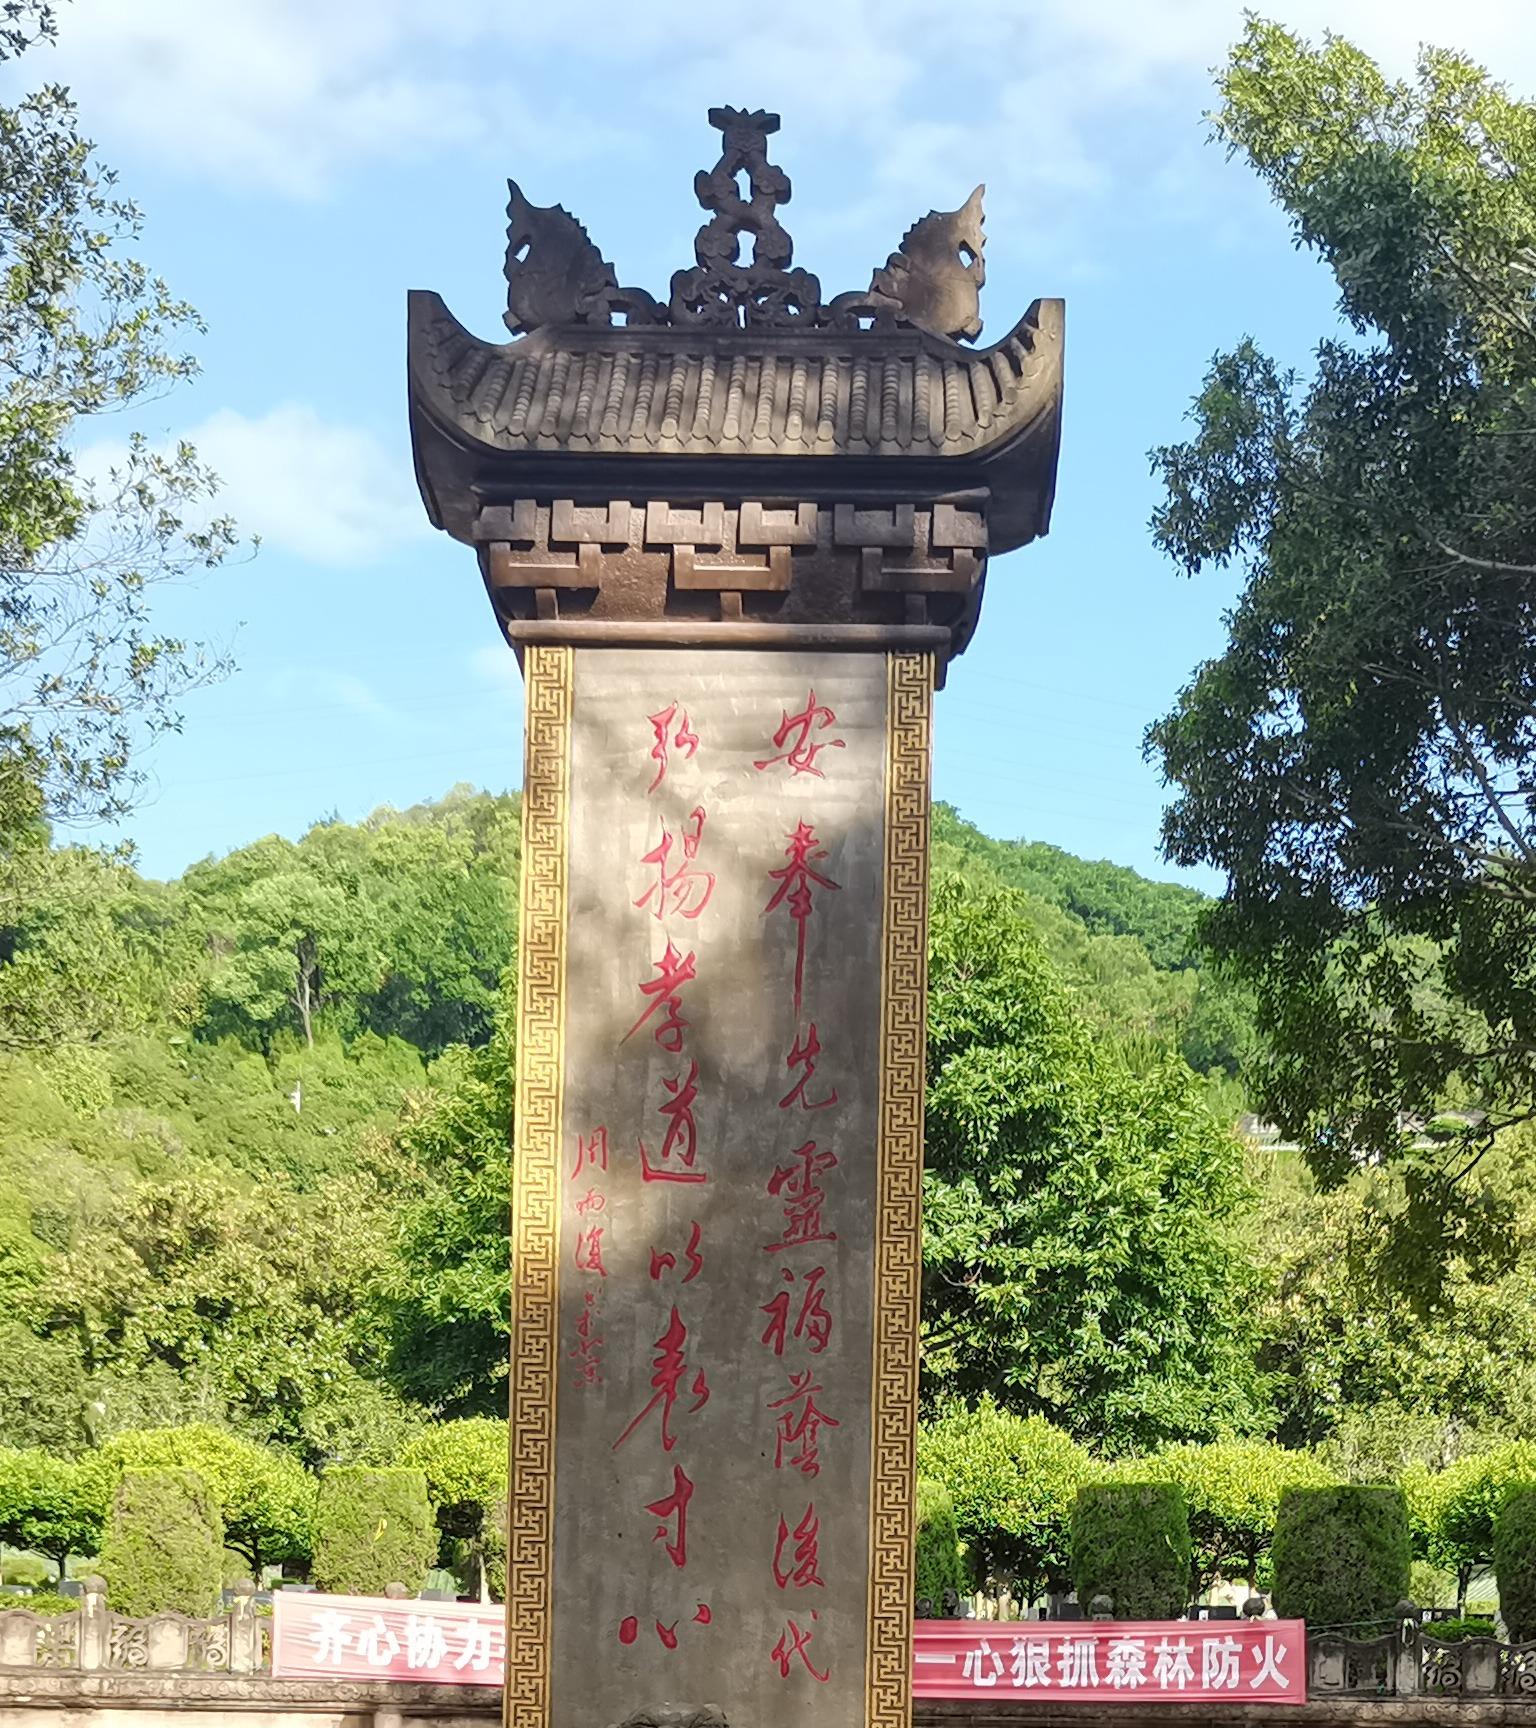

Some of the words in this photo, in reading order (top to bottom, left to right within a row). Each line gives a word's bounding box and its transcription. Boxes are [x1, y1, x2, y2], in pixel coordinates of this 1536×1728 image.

[311, 1610, 505, 1672] 齐心协力
[914, 1634, 1290, 1691] 一心狠抓森林防火
